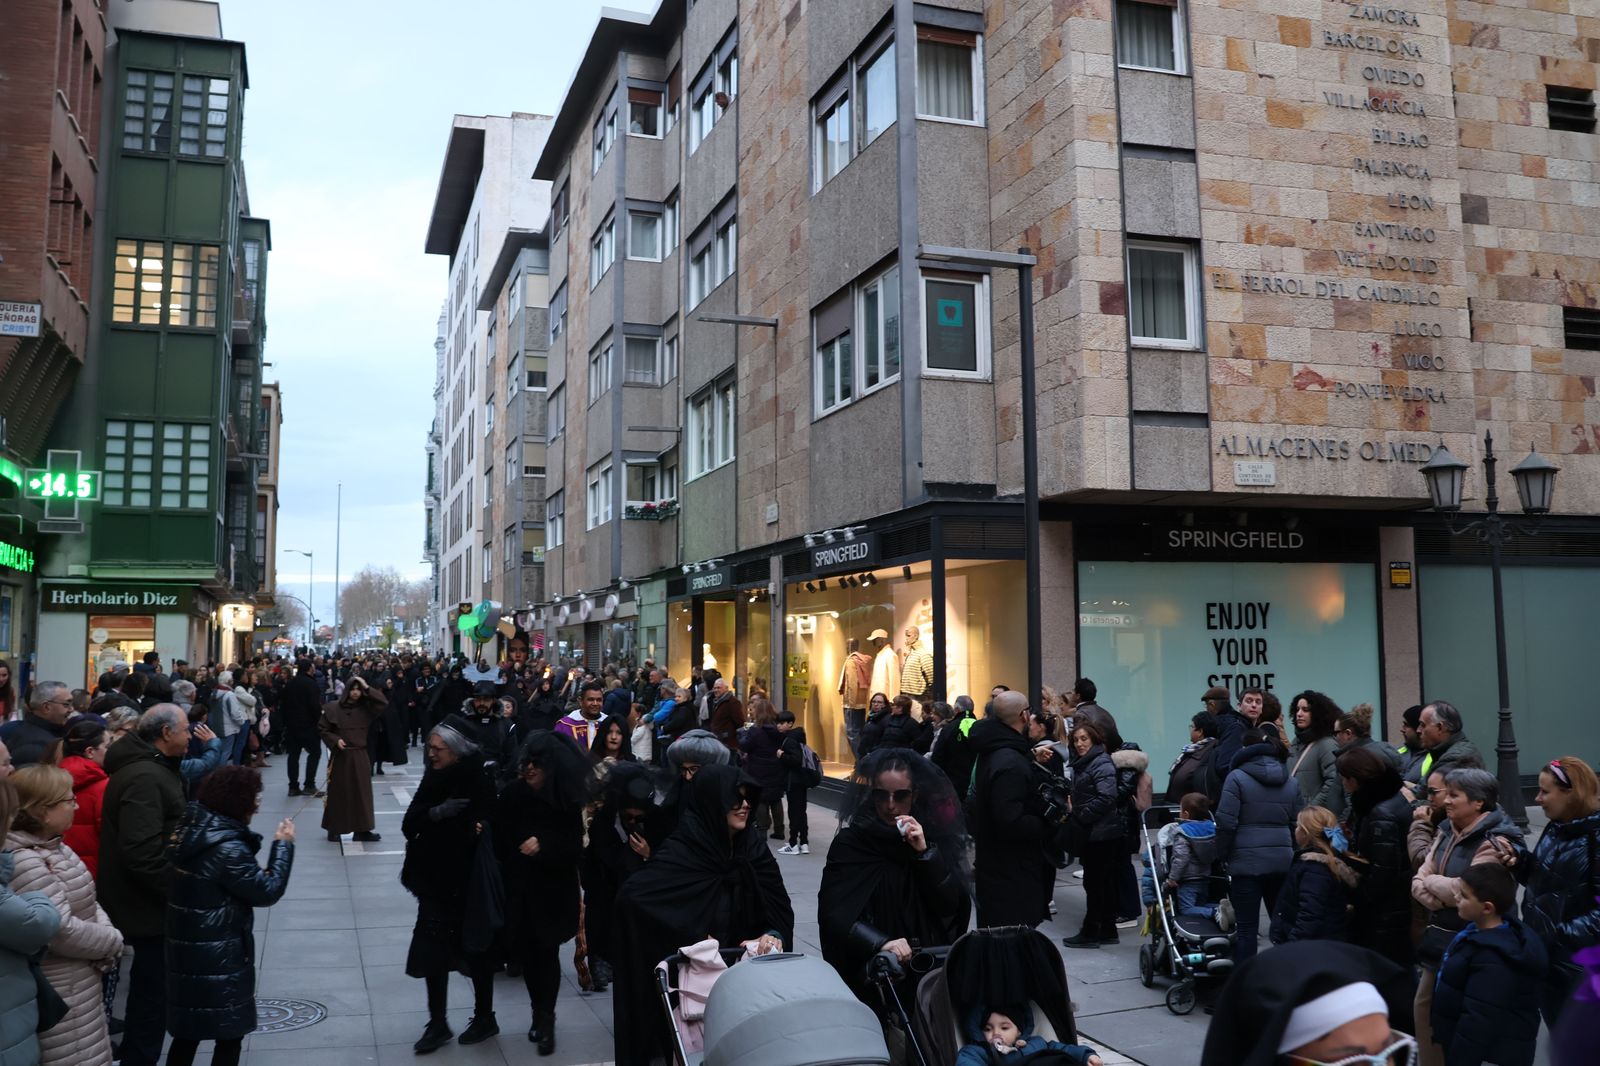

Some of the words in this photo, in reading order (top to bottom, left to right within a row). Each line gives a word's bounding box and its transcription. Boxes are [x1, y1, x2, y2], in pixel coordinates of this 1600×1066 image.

[1349, 5, 1420, 27] ZAMORA
[1323, 30, 1422, 57] BARCELONA
[1361, 66, 1425, 87] OVIEDO
[1371, 128, 1429, 149] BILBAO
[1353, 157, 1432, 181] PALENCIA
[1388, 192, 1434, 211] LEON
[1355, 221, 1436, 243] SANTIAGO
[1335, 250, 1439, 275] VALLADOLID
[1212, 273, 1234, 289] EL
[1241, 275, 1310, 296] FERROL
[1316, 281, 1350, 299] DEL
[1357, 285, 1441, 306] CAUDILLO
[1395, 321, 1442, 338] LUGO
[1401, 353, 1445, 371] VIGO
[1335, 382, 1447, 404] PONTEVEDRA
[1216, 435, 1350, 460] ALMACENES
[1168, 530, 1304, 549] SPRINGFIELD
[815, 542, 868, 567] SPRINGFIELD
[692, 573, 723, 590] SPRINGFIELD
[51, 590, 139, 605] Herbolario
[142, 592, 178, 605] Diez
[1206, 602, 1271, 630] ENJOY
[1212, 638, 1269, 666] YOUR
